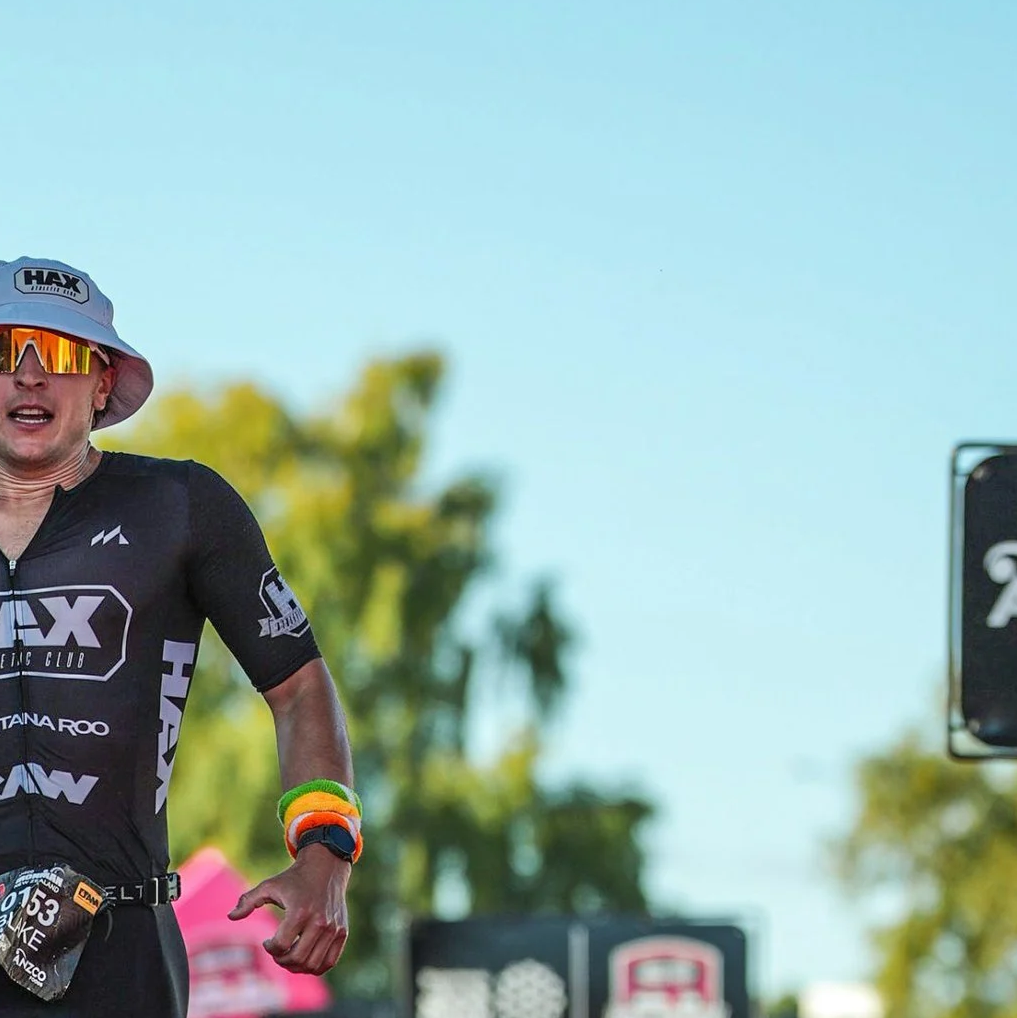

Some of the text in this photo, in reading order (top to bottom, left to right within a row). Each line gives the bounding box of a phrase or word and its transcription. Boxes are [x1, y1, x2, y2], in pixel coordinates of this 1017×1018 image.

[24, 270, 82, 294] HAX
[45, 651, 85, 668] CLUB
[58, 718, 110, 736] ROO
[0, 886, 60, 927] 0153
[13, 949, 47, 982] ANZCO
